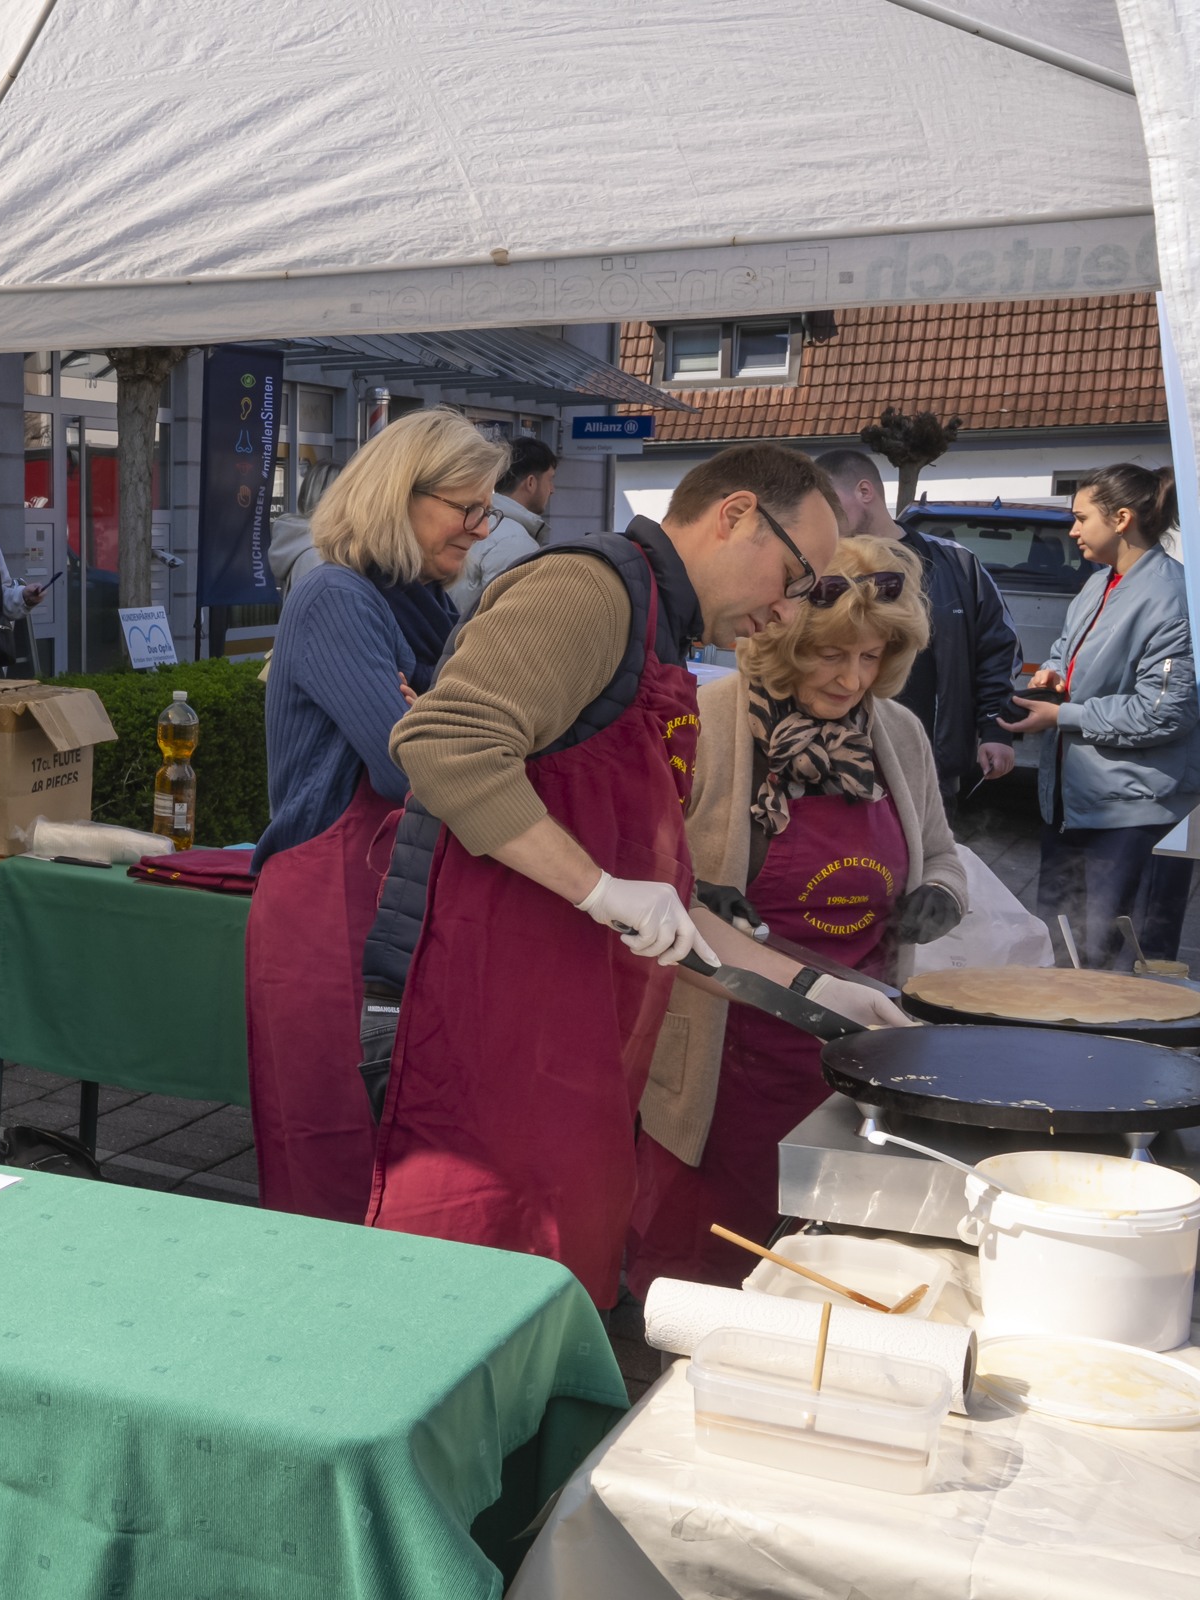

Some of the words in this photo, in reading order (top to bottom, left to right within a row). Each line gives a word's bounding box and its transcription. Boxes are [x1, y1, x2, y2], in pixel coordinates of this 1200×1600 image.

[584, 422, 622, 432] Allianz
[251, 486, 266, 587] LAUCHRINGEN
[261, 376, 274, 479] #mitallenSinnen
[121, 611, 166, 622] KUNDENPARKPLATZ
[53, 748, 81, 769] FLUTE
[46, 771, 79, 790] PIECES
[843, 857, 858, 867] DE
[861, 858, 894, 896] CHANDIEU
[827, 895, 869, 905] 1996-2006
[803, 910, 875, 934] LAUCHRINGEN
